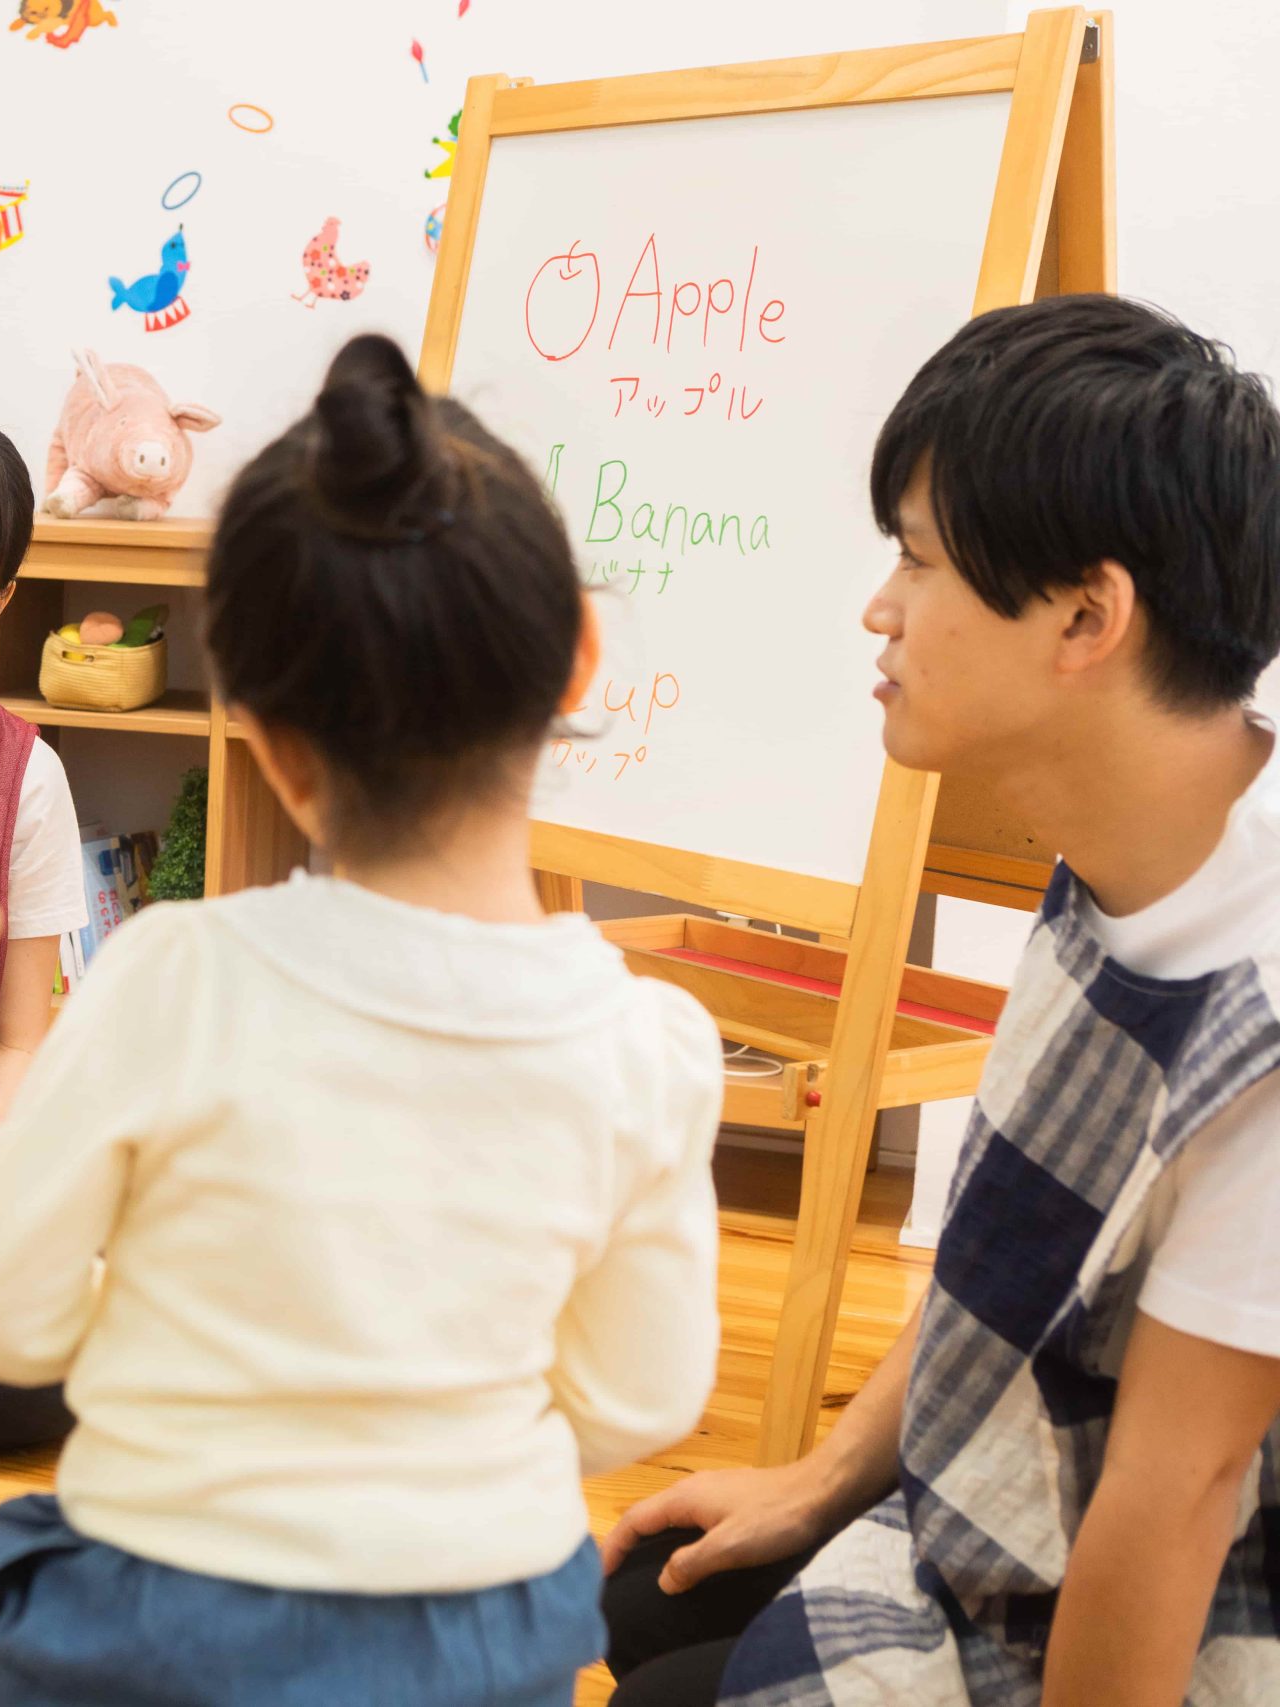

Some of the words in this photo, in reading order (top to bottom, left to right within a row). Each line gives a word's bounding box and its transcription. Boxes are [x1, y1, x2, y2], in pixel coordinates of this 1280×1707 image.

[608, 232, 786, 353] Apple
[609, 371, 764, 420] アップル
[584, 459, 770, 556] Banana
[586, 559, 674, 595] バナナ
[563, 671, 680, 735] up
